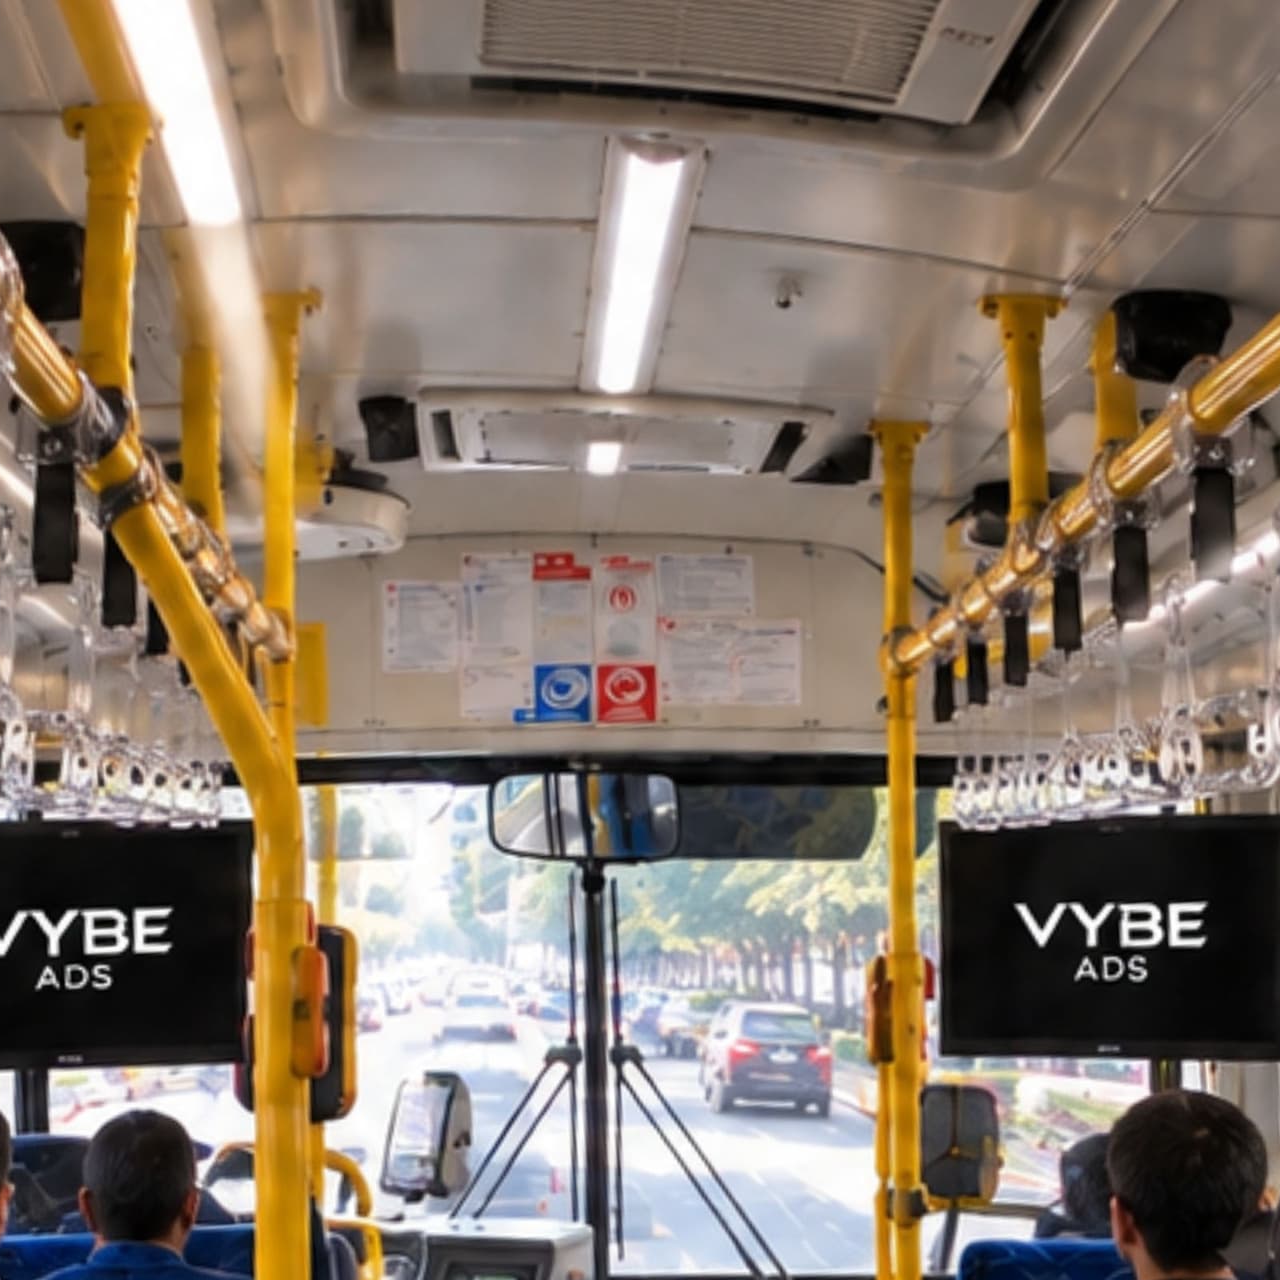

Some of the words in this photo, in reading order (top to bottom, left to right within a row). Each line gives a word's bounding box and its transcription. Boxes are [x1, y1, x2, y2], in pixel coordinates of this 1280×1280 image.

[1014, 901, 1208, 948] VYBE
[35, 963, 113, 990] ADS
[1074, 954, 1148, 983] ADS
